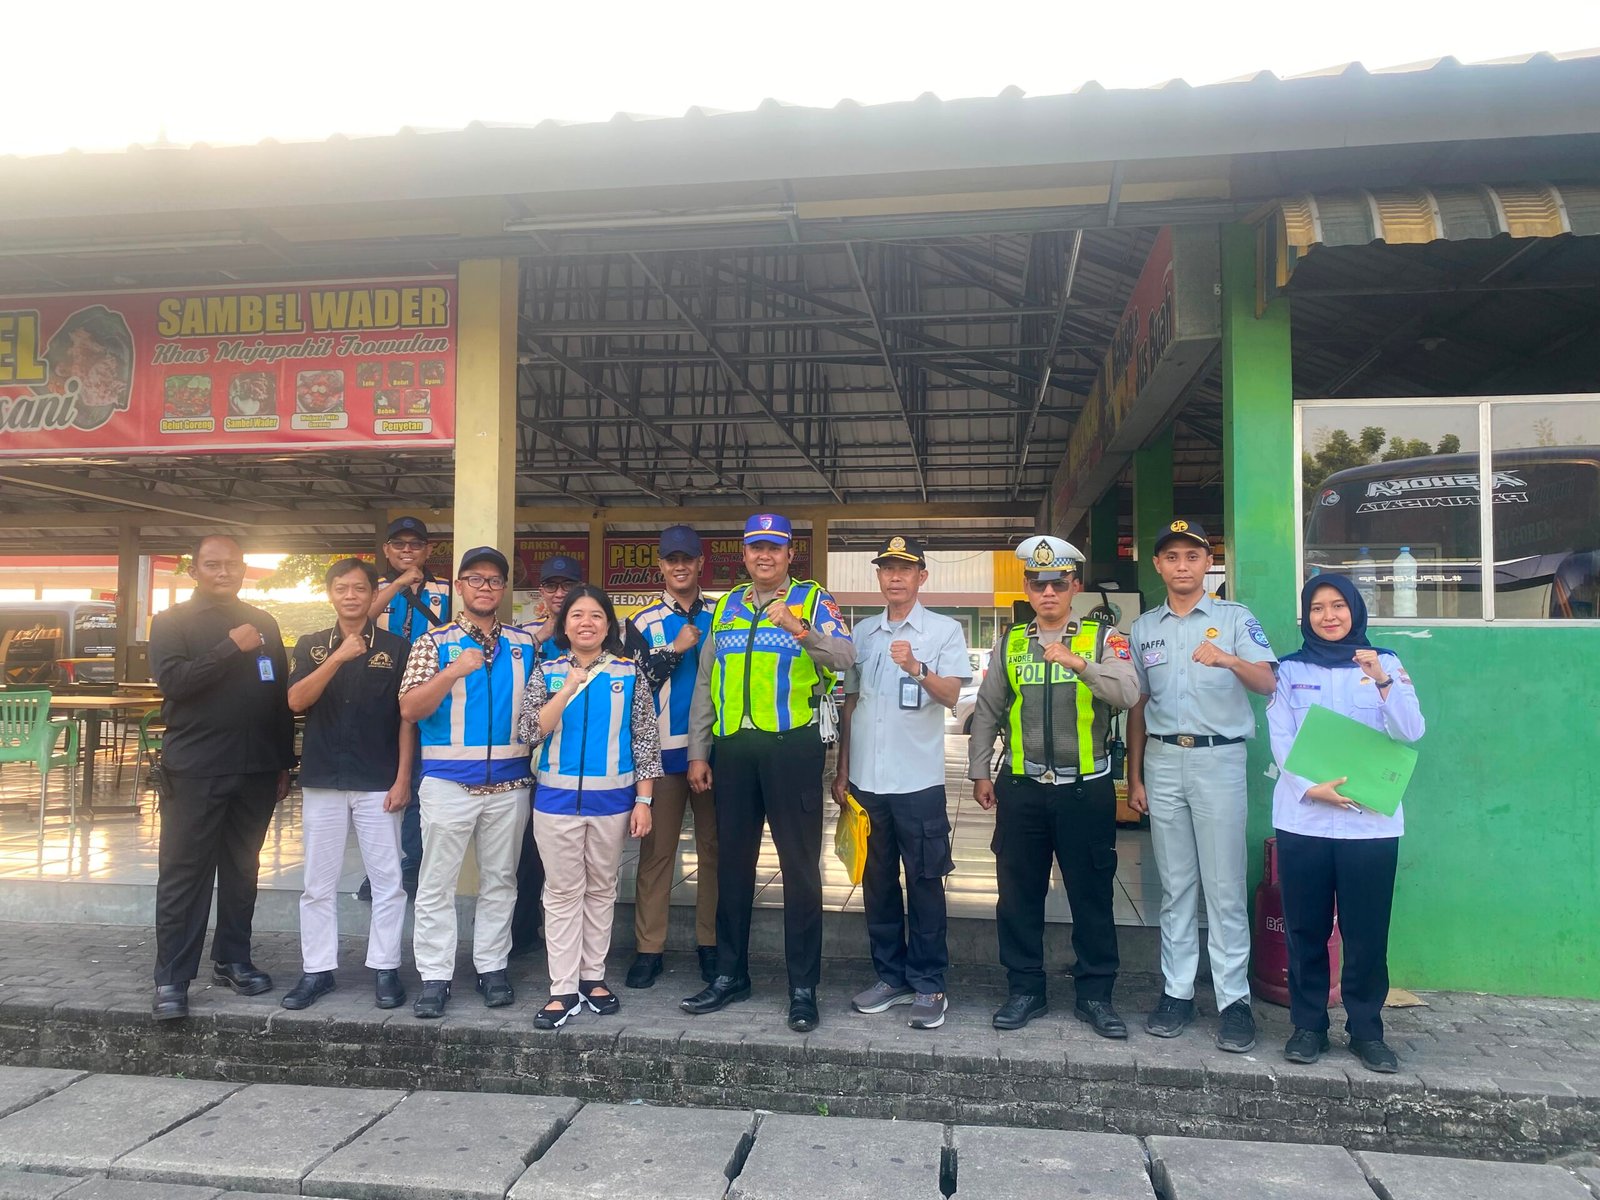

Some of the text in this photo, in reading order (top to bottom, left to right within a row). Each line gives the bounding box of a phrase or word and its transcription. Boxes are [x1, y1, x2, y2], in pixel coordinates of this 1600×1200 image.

[157, 286, 448, 338] SAMBEL WADER
[151, 333, 449, 365] Khas Majapahit Trowulan
[162, 420, 213, 431] Belut Goreng
[226, 418, 278, 429] Sambel Wader
[382, 420, 423, 432] Penyetan
[520, 541, 559, 550] BAKSO
[609, 544, 660, 568] PECE
[608, 567, 651, 586] mbok
[1141, 639, 1166, 650] DAFFA
[1008, 654, 1032, 664] ANDRE
